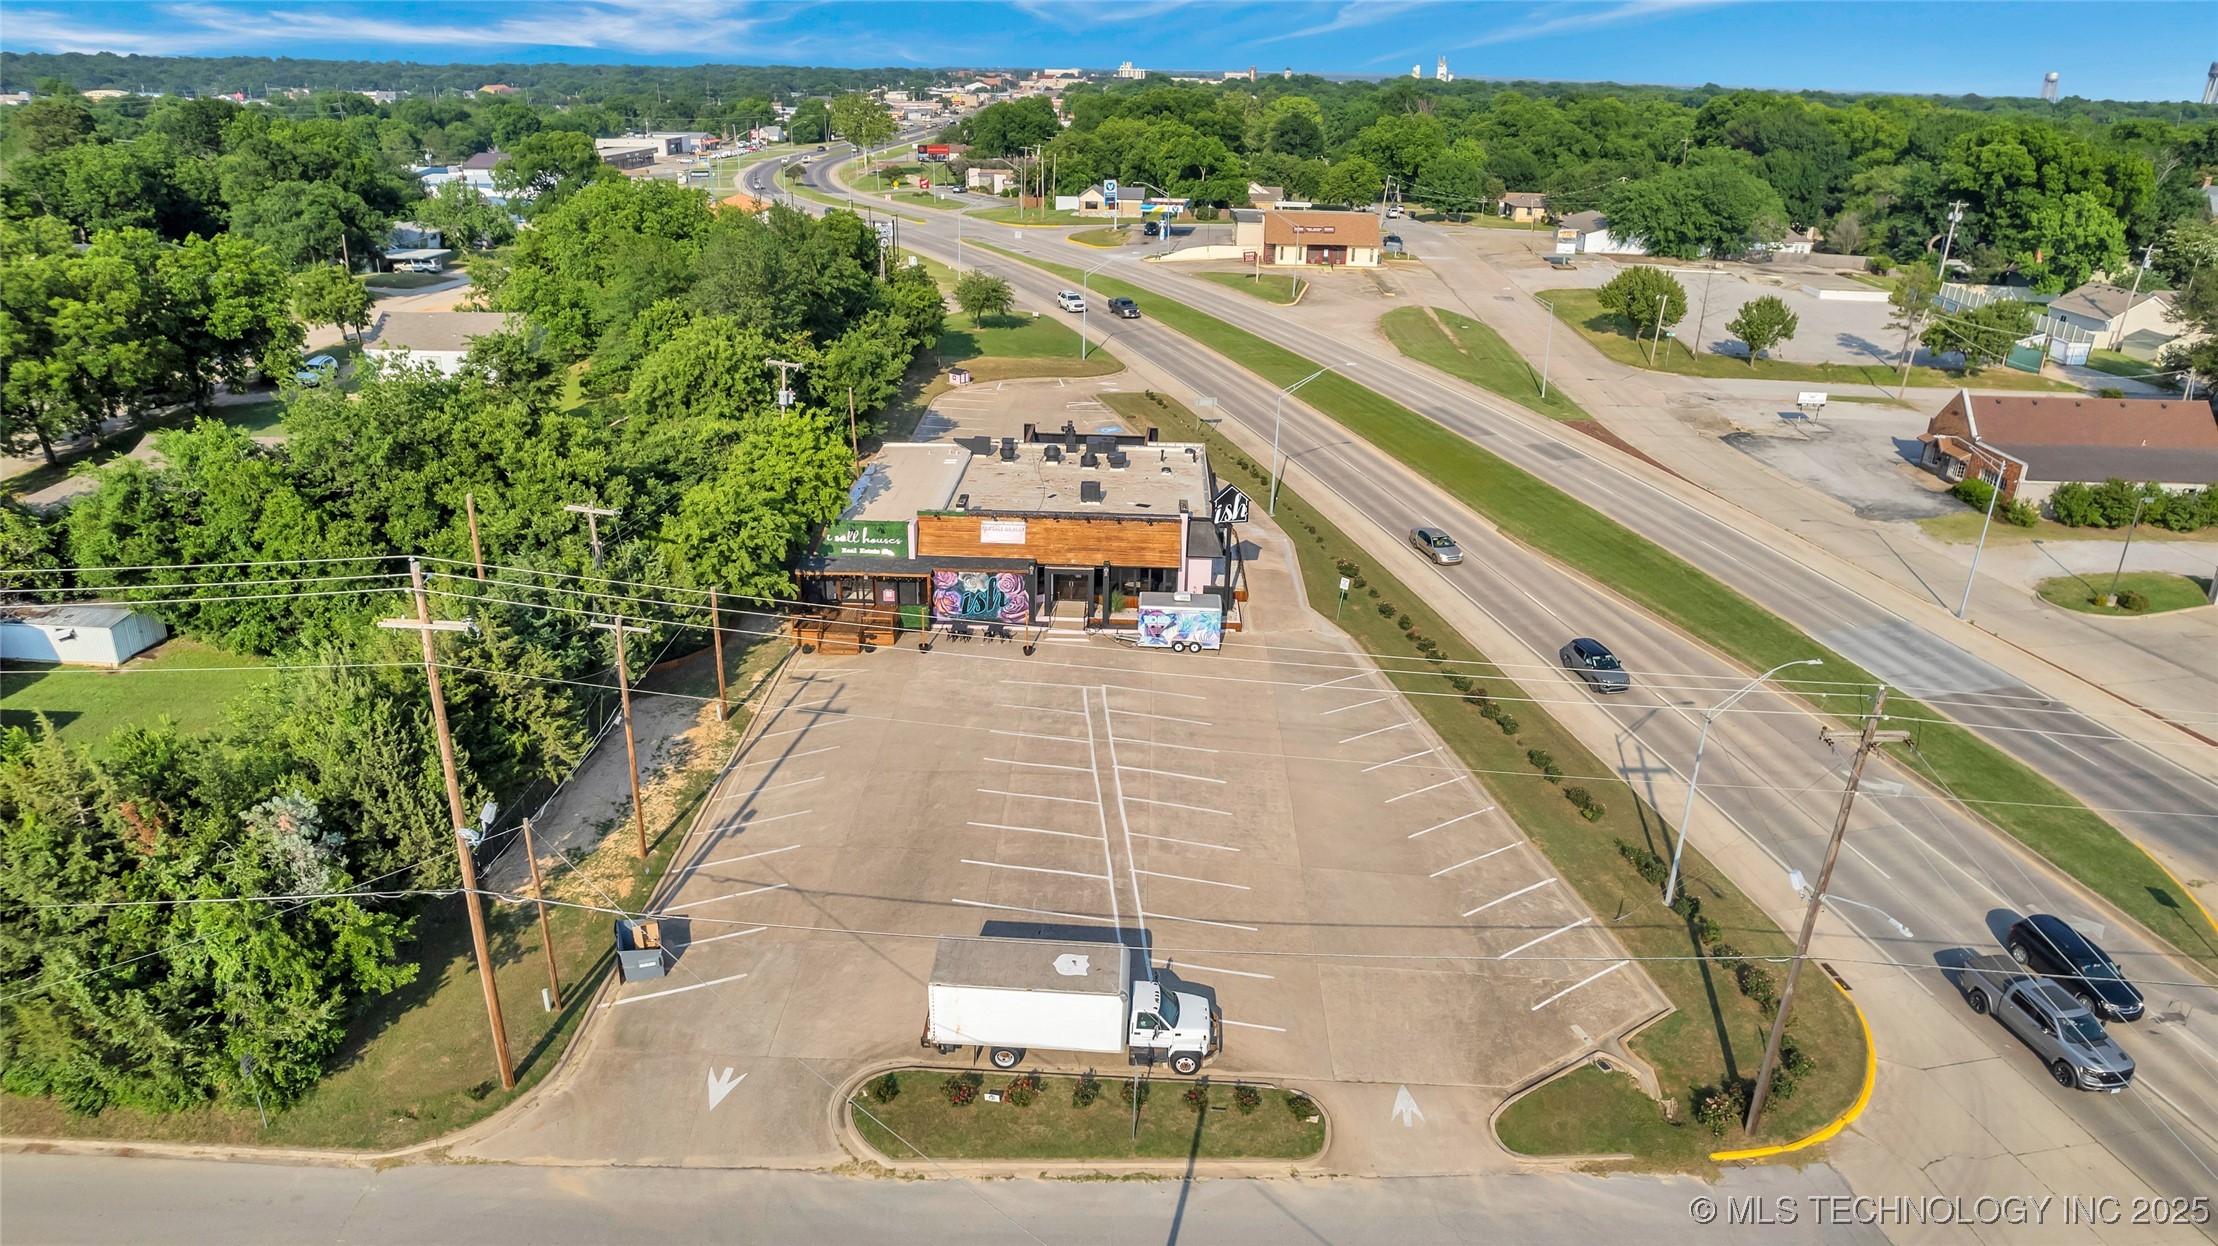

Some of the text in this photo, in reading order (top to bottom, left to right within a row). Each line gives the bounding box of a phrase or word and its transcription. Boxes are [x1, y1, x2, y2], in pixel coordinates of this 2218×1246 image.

[1214, 493, 1248, 524] ish
[834, 530, 859, 543] sell
[862, 527, 902, 544] houses
[961, 576, 1008, 615] ish
